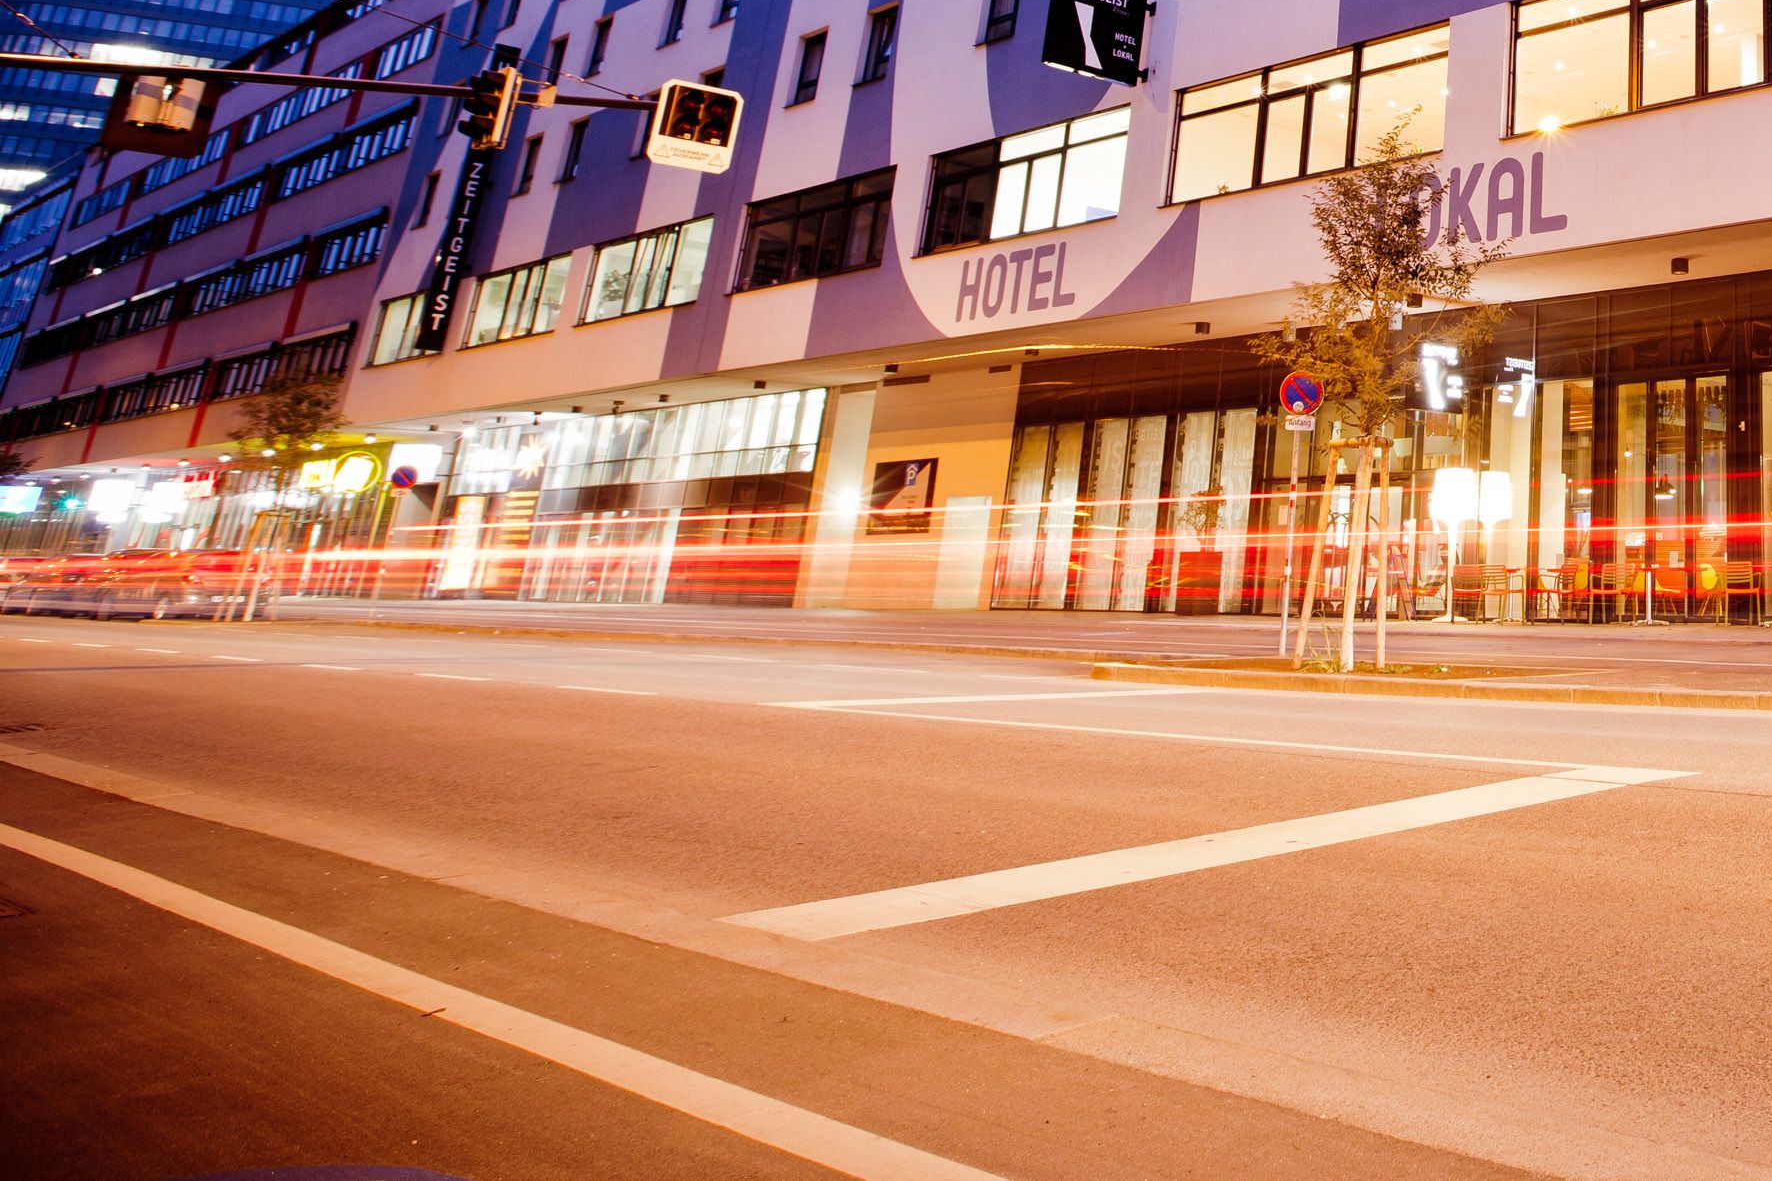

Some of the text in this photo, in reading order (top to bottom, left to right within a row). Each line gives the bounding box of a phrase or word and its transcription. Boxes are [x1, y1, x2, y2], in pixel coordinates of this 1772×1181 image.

[1114, 32, 1137, 46] HOTEL
[1112, 48, 1135, 62] LOKAL
[431, 162, 484, 331] ZEITGEIST
[955, 241, 1076, 323] HOTEL
[1288, 419, 1312, 428] Anfang
